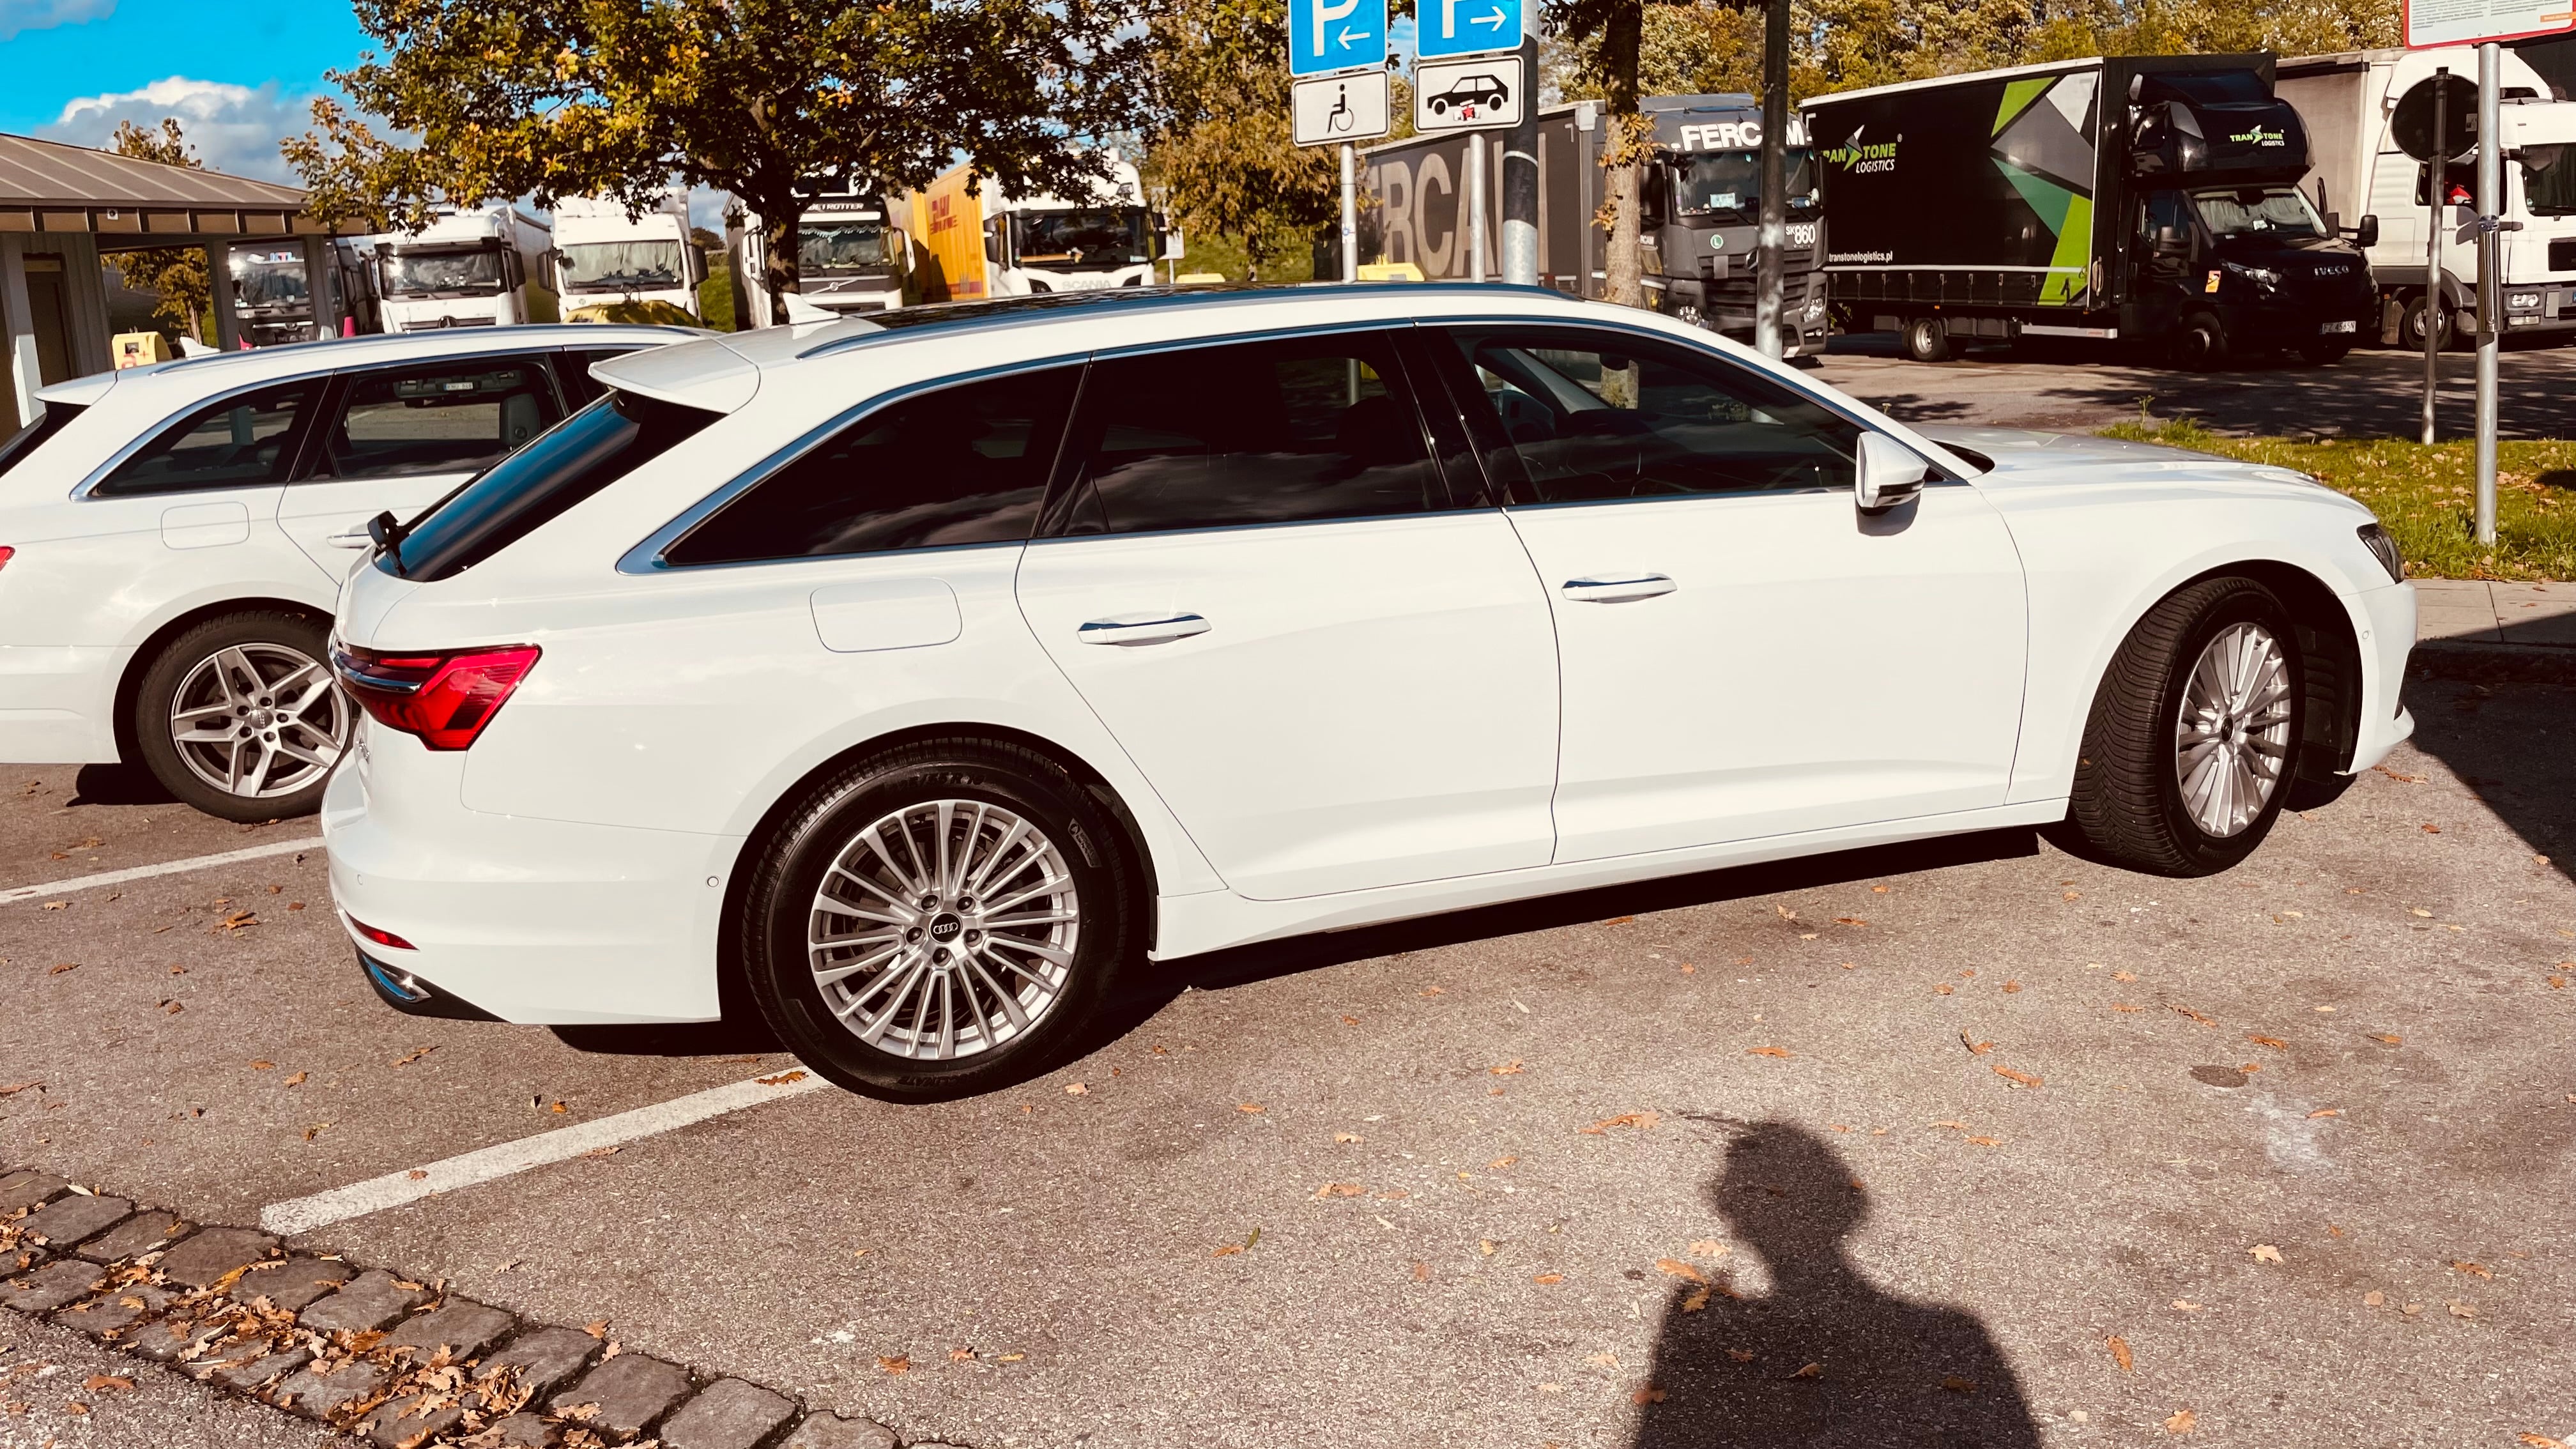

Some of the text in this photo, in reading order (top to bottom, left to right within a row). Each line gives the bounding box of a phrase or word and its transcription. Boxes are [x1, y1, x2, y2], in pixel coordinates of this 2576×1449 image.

[1680, 120, 1805, 151] FERCM
[1856, 159, 1895, 174] LOGISTICS
[2315, 265, 2349, 276] IVECO
[1062, 279, 1112, 290] SCANIA
